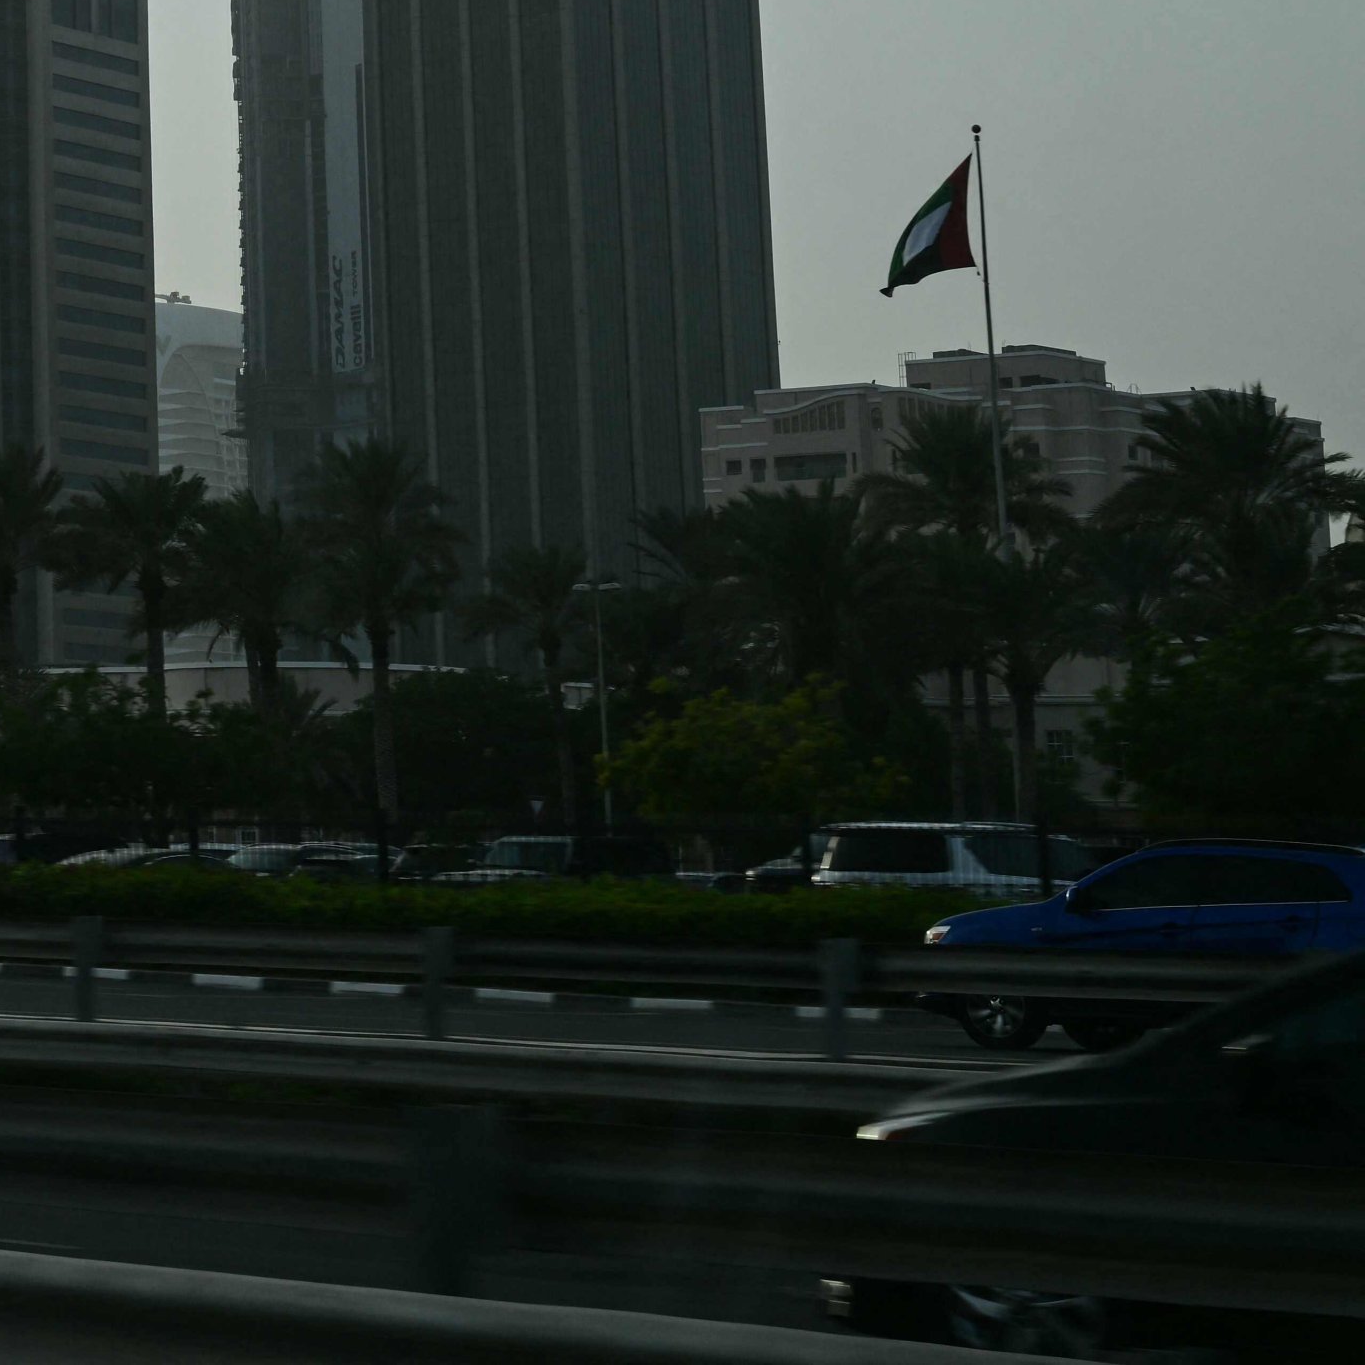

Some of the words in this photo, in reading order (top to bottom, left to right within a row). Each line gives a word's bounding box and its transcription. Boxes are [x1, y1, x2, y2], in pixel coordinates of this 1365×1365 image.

[350, 250, 358, 298] TOWER
[332, 255, 345, 369] DAMAC
[350, 303, 363, 367] cavalli
